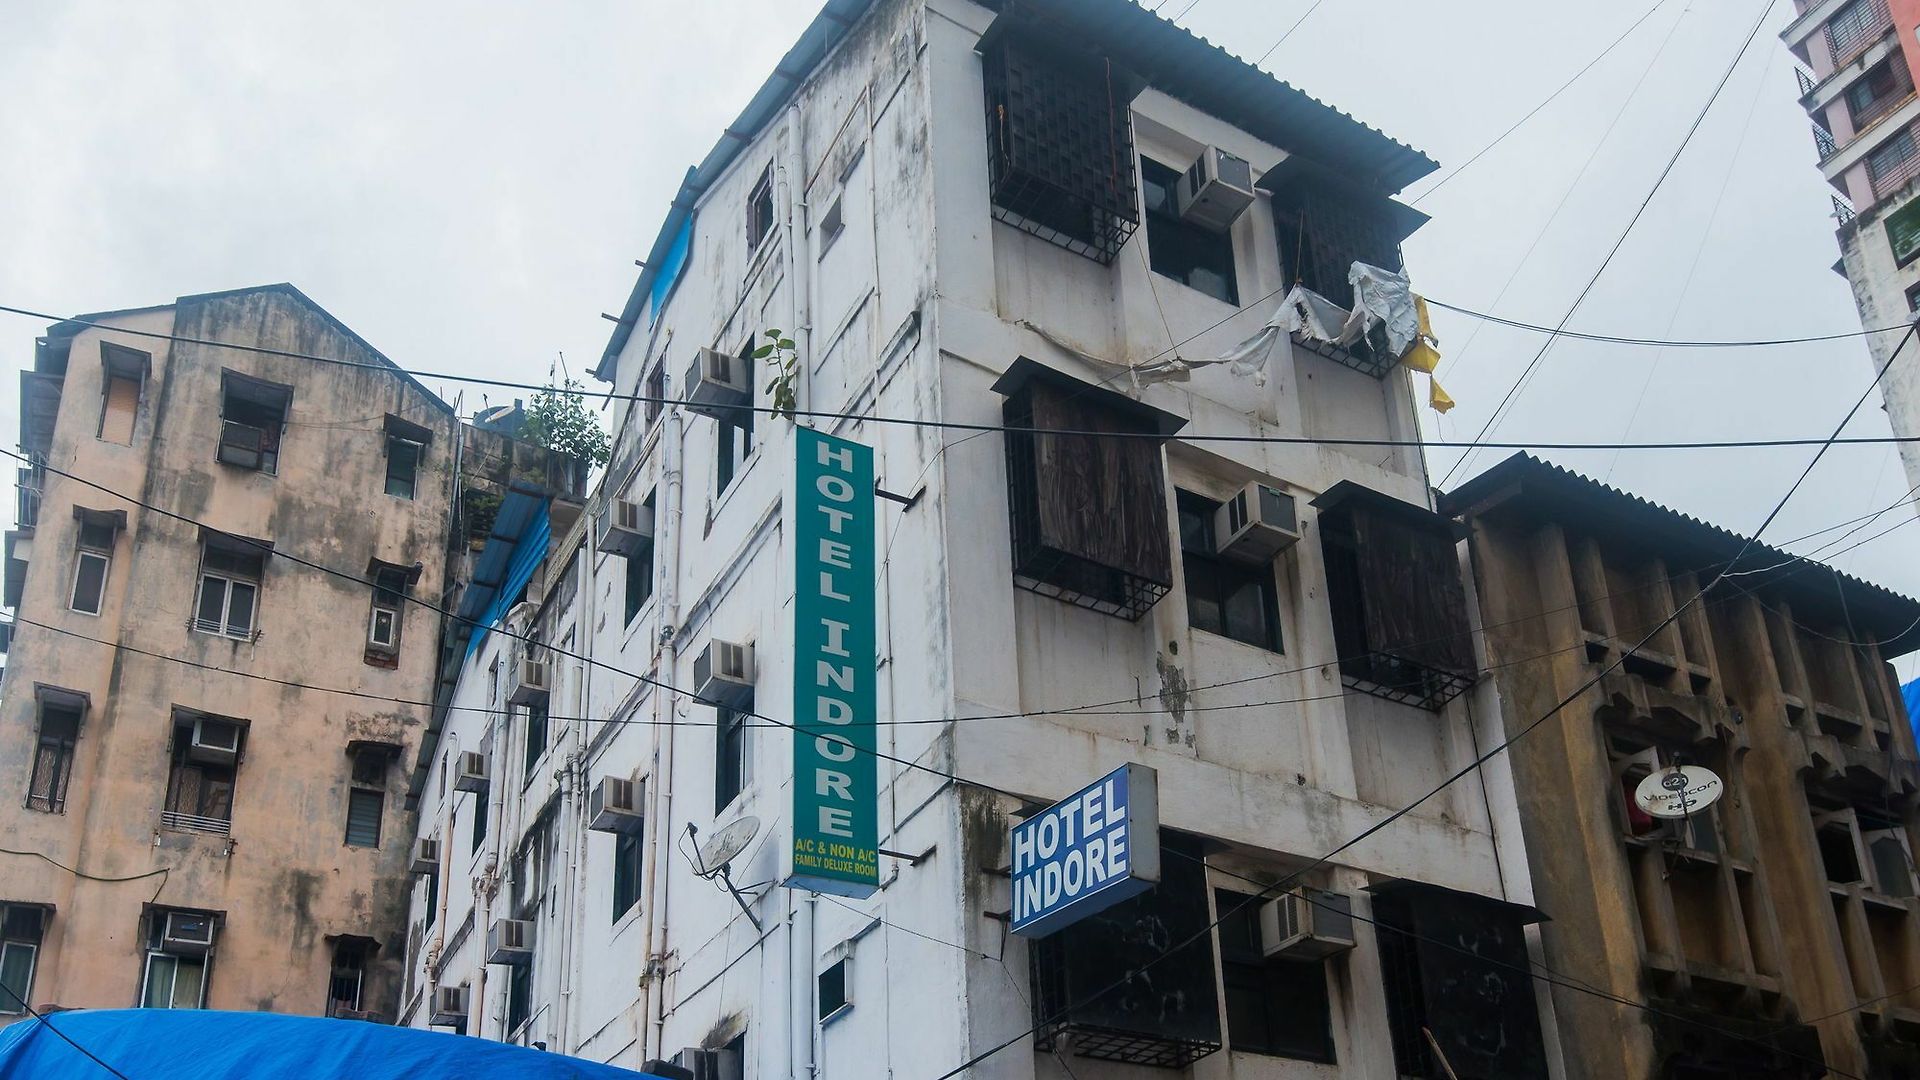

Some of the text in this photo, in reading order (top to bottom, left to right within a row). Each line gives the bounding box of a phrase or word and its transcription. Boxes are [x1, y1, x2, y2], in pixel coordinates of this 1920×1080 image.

[815, 441, 855, 838] HOTEL INDORE
[795, 838, 876, 863] A/C & NON A/C
[795, 853, 877, 877] FAMILY DELUXE ROOM
[1014, 778, 1126, 875] HOTEL
[1014, 824, 1127, 923] INDORE
